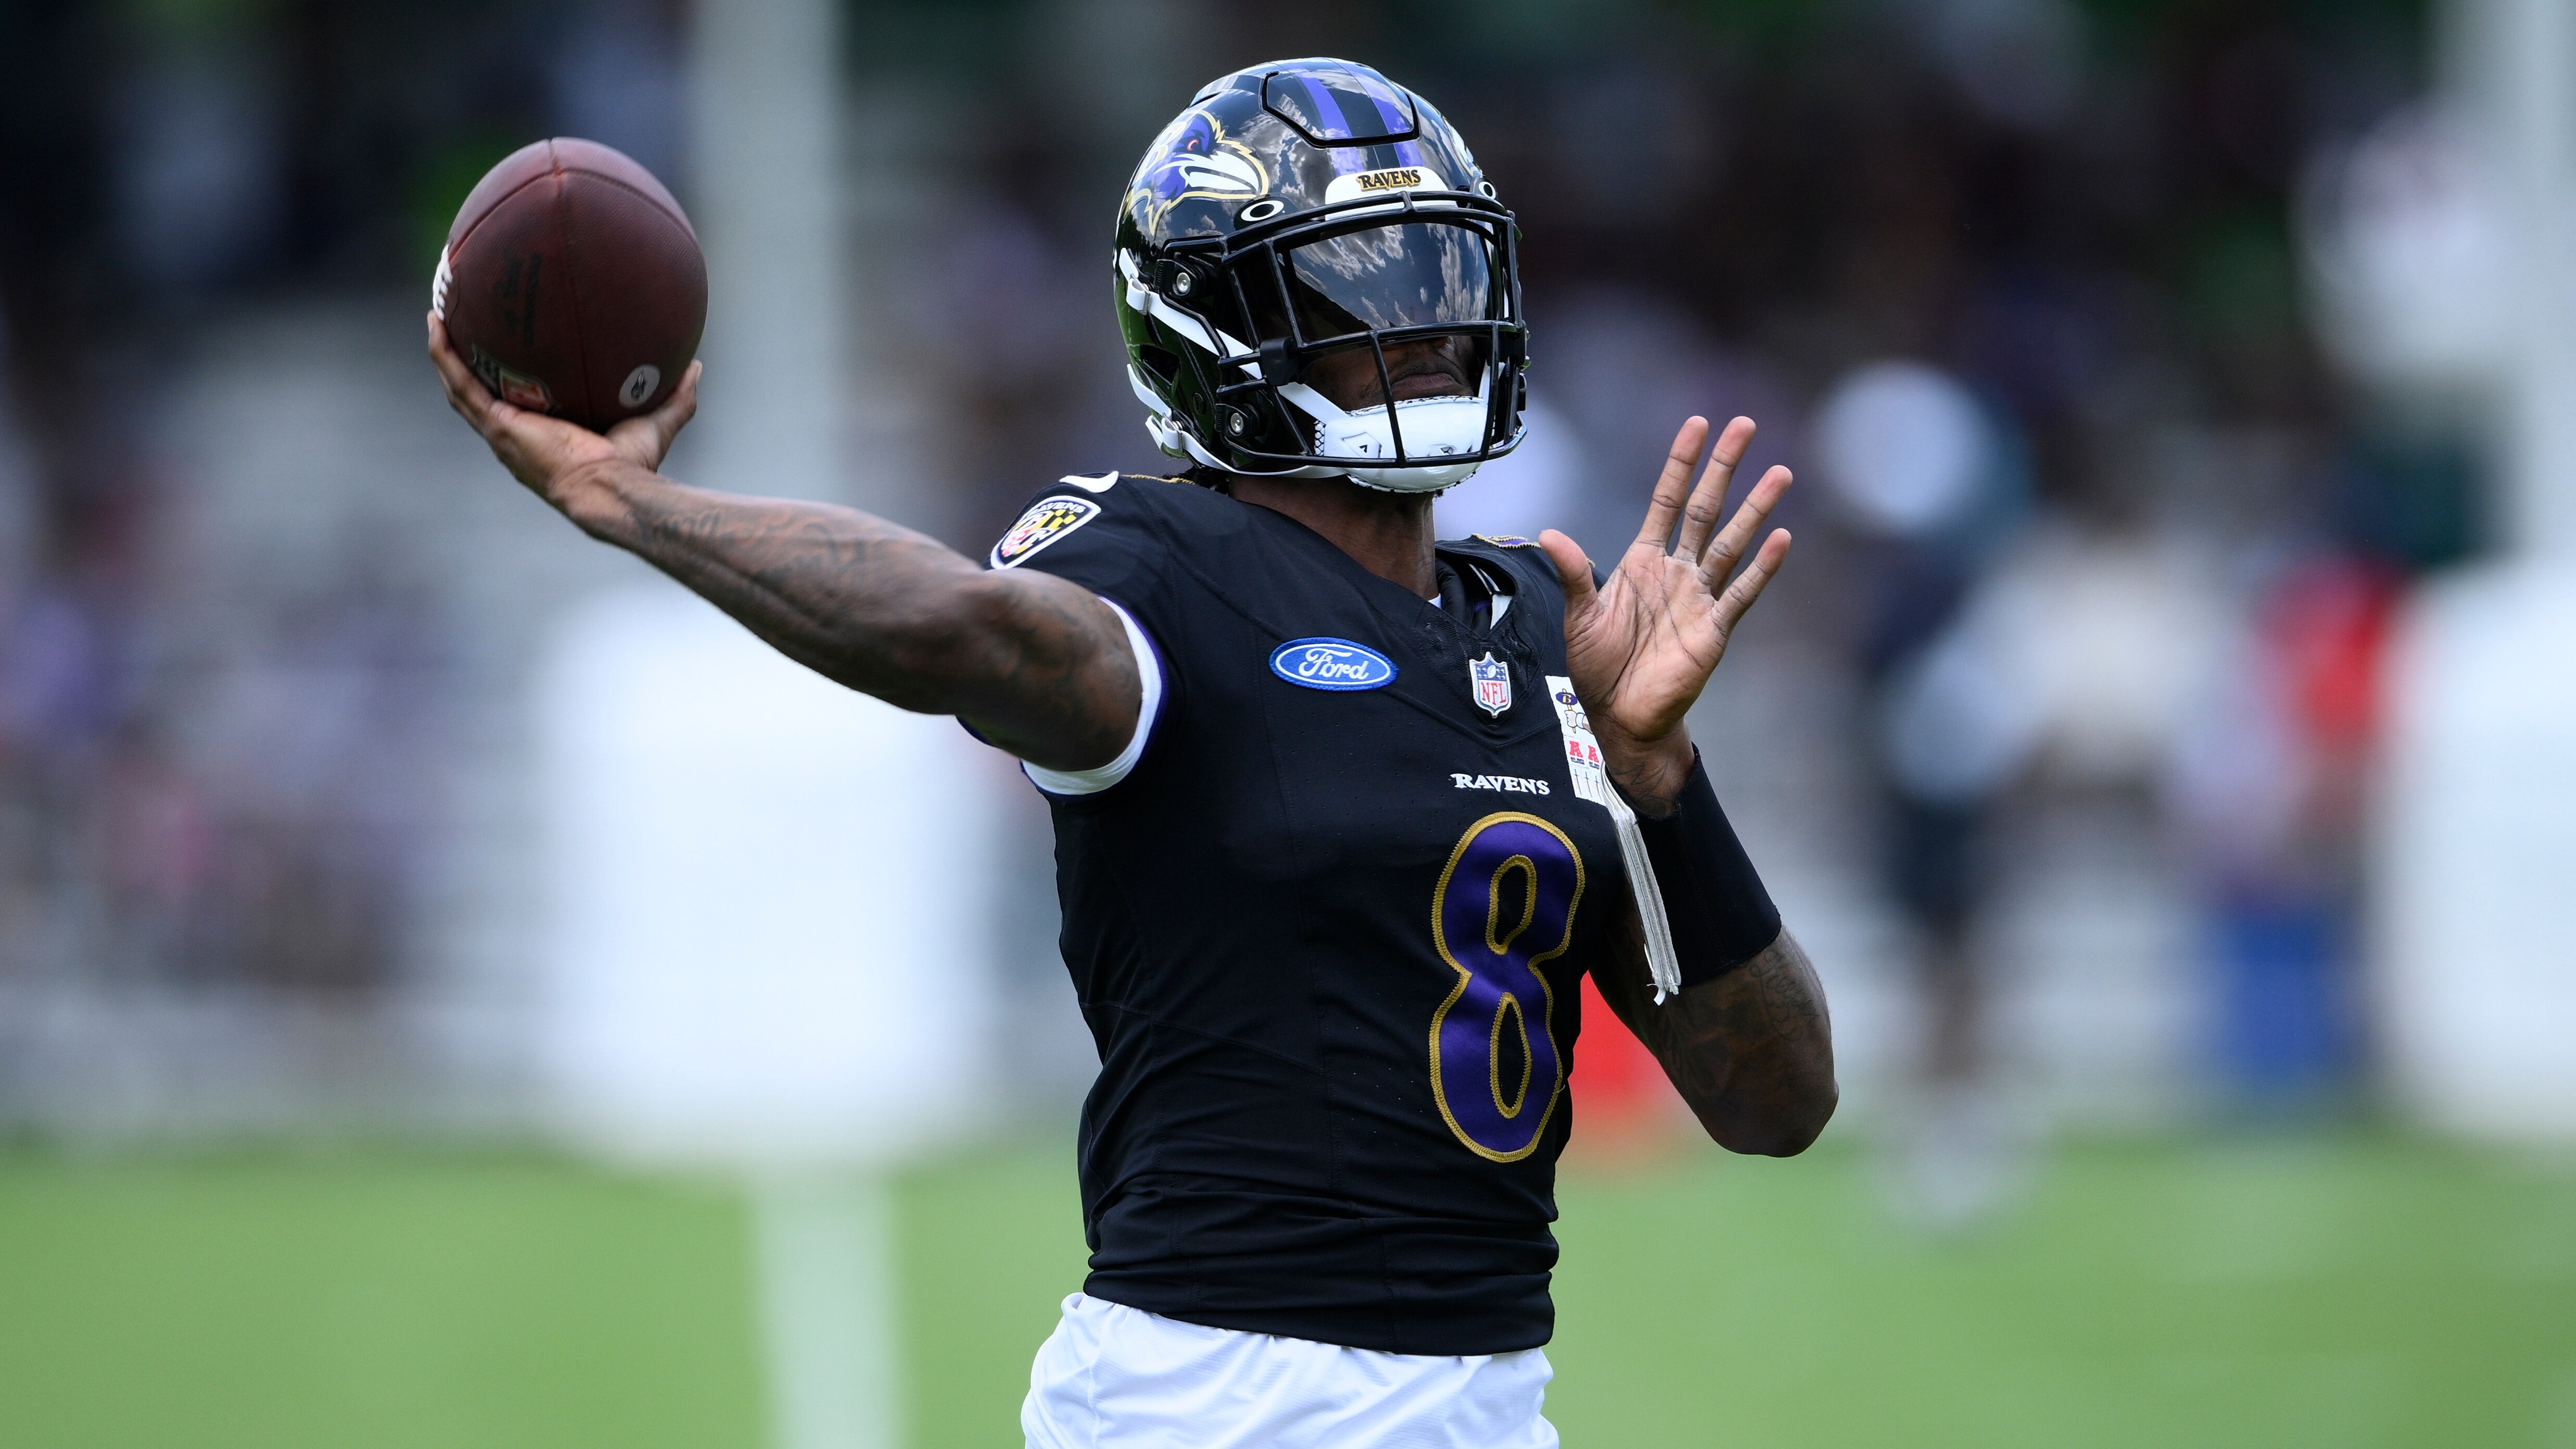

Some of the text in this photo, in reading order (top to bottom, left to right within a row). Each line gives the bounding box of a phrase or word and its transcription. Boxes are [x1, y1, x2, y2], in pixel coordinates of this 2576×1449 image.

[1356, 169, 1421, 191] RAVENS
[1298, 648, 1370, 680] Ford
[1480, 682, 1507, 706] NFL
[1450, 773, 1551, 795] RAVENS
[1429, 811, 1585, 1162] 8
